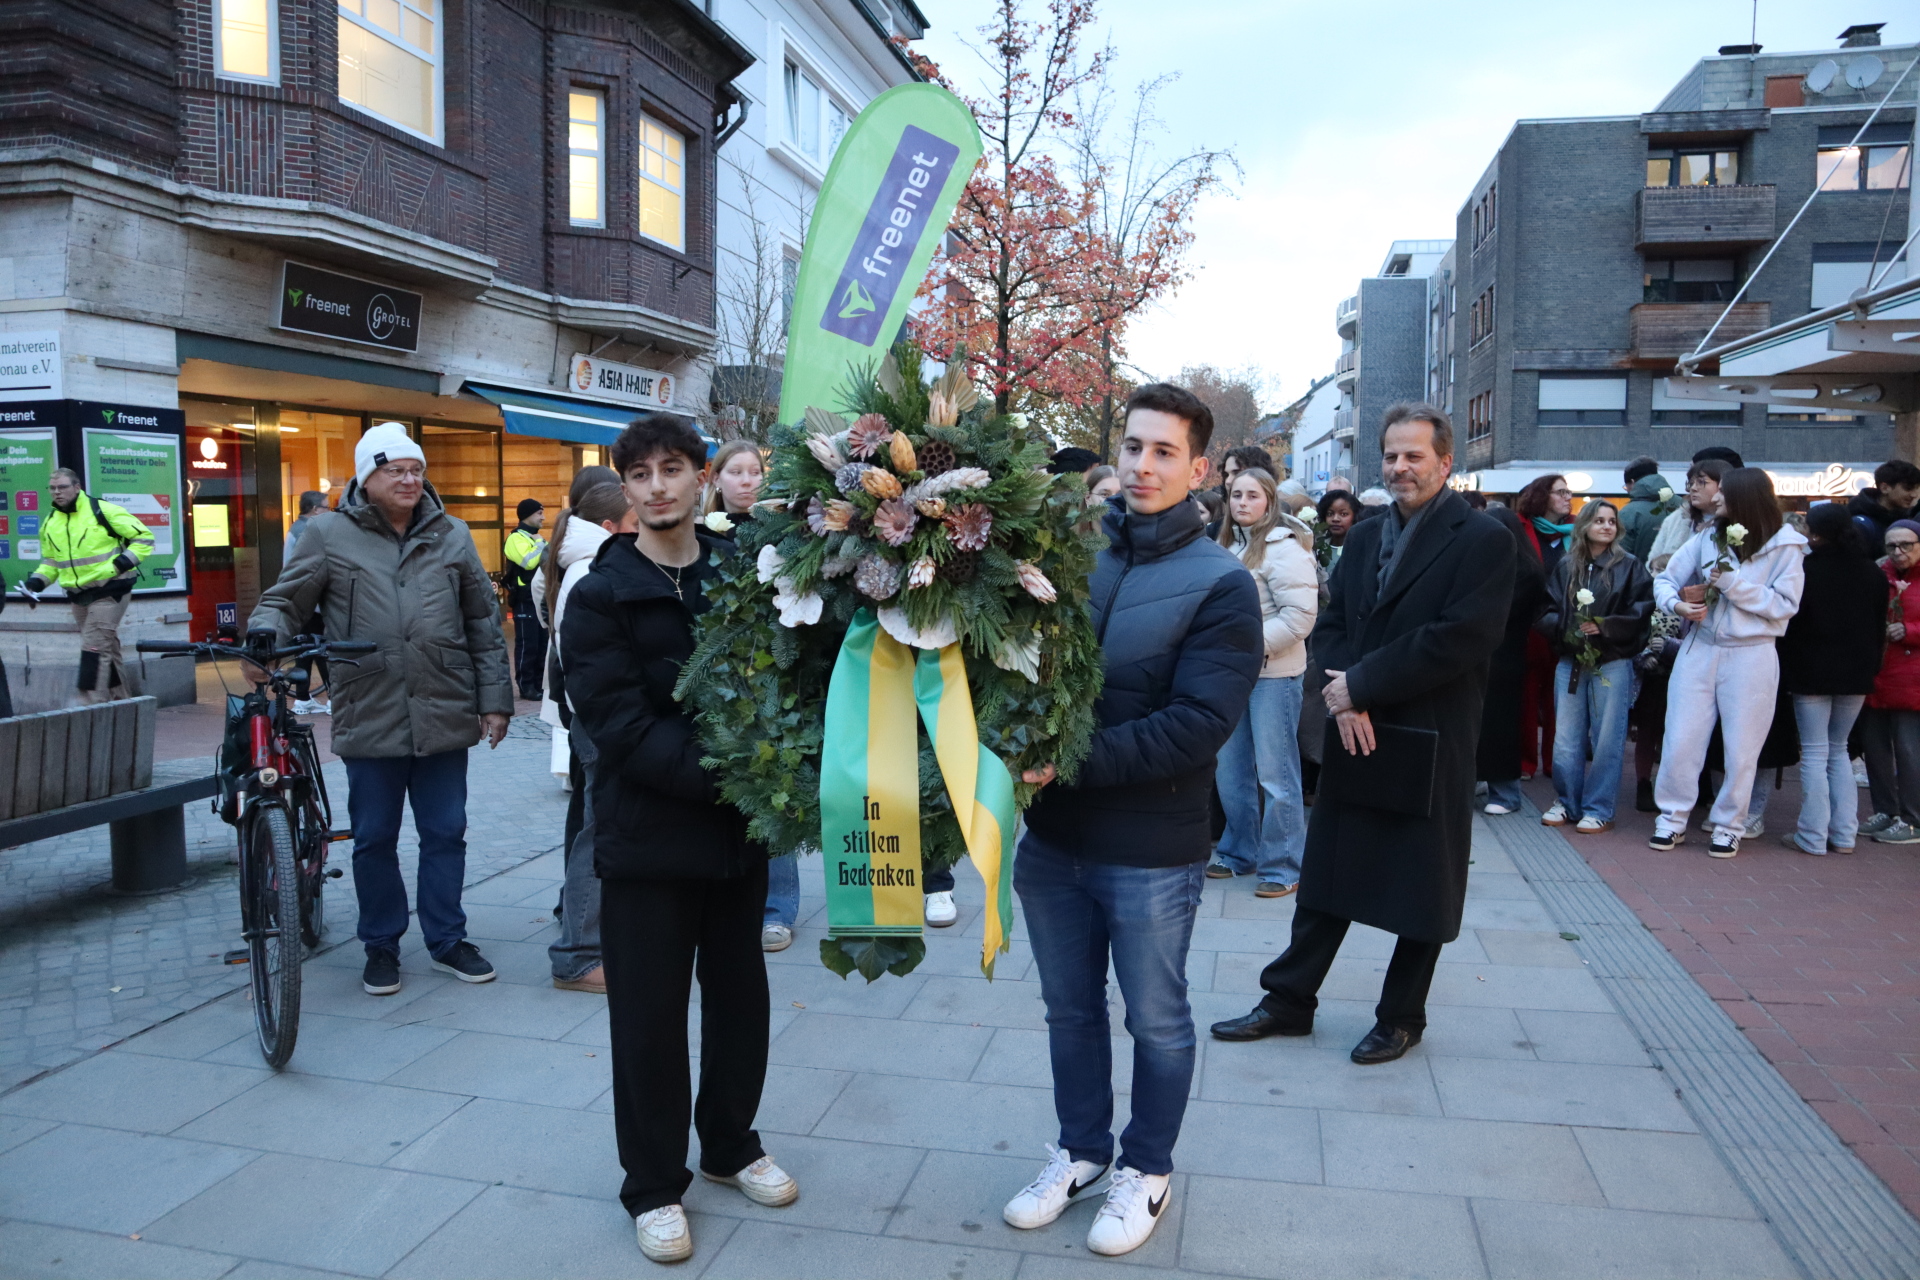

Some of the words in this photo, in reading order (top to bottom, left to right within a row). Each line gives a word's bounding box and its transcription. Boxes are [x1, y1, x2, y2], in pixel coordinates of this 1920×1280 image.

[862, 151, 939, 278] freenet
[305, 293, 351, 317] freenet
[31, 358, 54, 374] e.V.
[598, 368, 623, 391] ASIA
[625, 373, 654, 397] HAUS
[117, 412, 159, 426] freenet
[9, 446, 28, 455] Dein
[99, 446, 168, 458] Zukunftssicheres
[100, 457, 135, 466] Internet
[135, 457, 148, 466] für
[148, 458, 166, 467] Dein
[192, 460, 228, 470] vodafone
[101, 466, 139, 475] Zuhause.
[218, 608, 235, 624] 1&1
[863, 795, 880, 821] In
[843, 829, 900, 853] stillem
[838, 861, 915, 887] Gedenken
